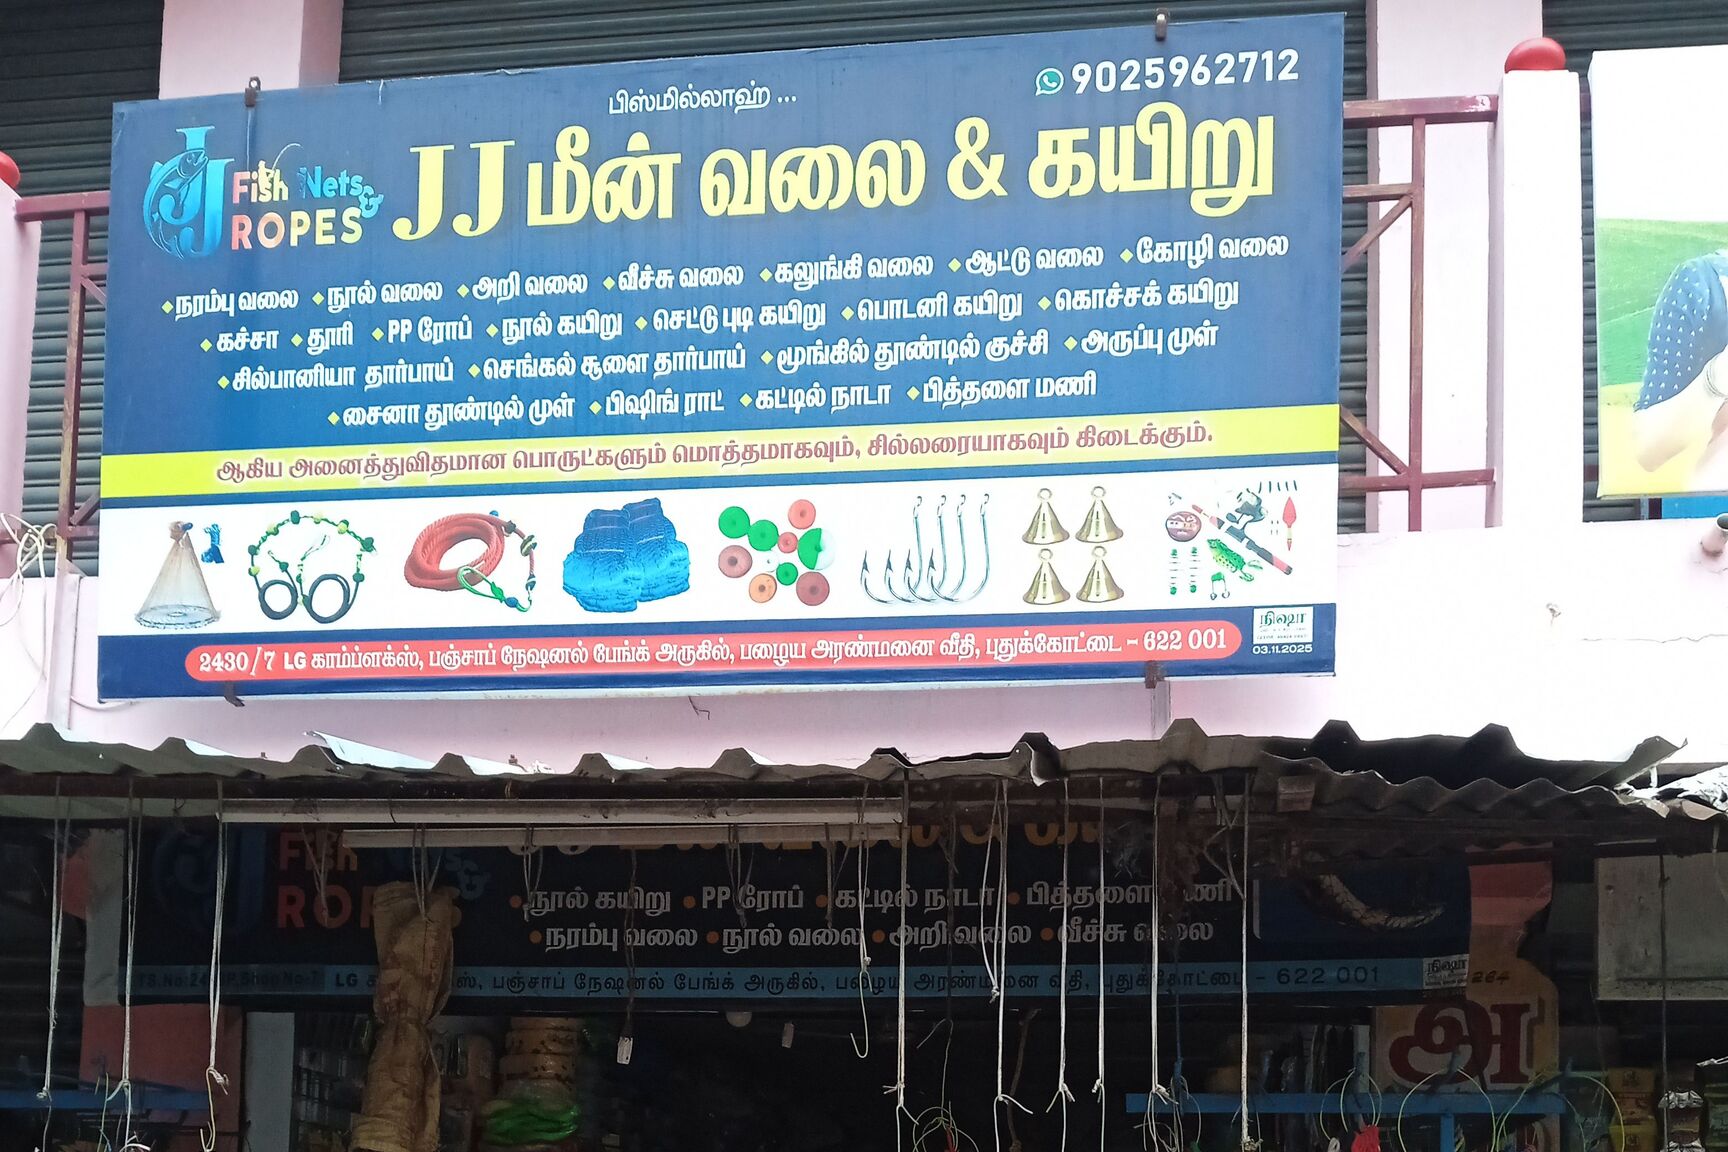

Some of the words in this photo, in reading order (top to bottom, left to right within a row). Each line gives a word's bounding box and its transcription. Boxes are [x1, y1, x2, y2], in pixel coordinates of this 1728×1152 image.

[1071, 49, 1299, 94] 9025962712
[299, 166, 362, 199] Nets
[393, 139, 516, 241] JJ
[526, 124, 682, 227] மீன்
[700, 139, 926, 217] வலை
[946, 115, 1009, 203] &
[1028, 101, 1275, 217] கயிறு
[231, 207, 363, 250] ROPES
[174, 289, 235, 321] நரம்பு
[238, 287, 299, 313] வலை
[327, 279, 376, 314] நூல்
[379, 281, 443, 306] வலை
[472, 271, 521, 304] அறி
[525, 273, 588, 298] வலை
[617, 262, 676, 293] வீச்சு
[679, 265, 744, 289] வலை
[774, 252, 864, 288] கலுங்கி
[867, 254, 934, 279] வலை
[965, 246, 1031, 277] ஆட்டு
[1035, 245, 1104, 271] வலை
[1135, 233, 1214, 267] கோழி
[1218, 235, 1290, 261] வலை
[216, 327, 279, 354] கச்சா
[387, 318, 412, 343] PP
[416, 315, 473, 346] ரோப்
[500, 311, 553, 345] நூல்
[556, 308, 623, 340] கயிறு
[758, 300, 828, 331] கயிறு
[952, 289, 1023, 321] கயிறு
[1166, 277, 1240, 309] கயிறு
[231, 360, 356, 392] சில்பானியா
[364, 354, 454, 390] தார்பாய்
[483, 349, 576, 382] செங்கல்
[580, 347, 649, 381] சூளை
[653, 340, 746, 376] தார்பாய்
[776, 338, 870, 373] மூங்கில்
[874, 332, 981, 371] தூண்டில்
[1167, 318, 1219, 355] முள்
[342, 401, 421, 428] சைனா
[424, 395, 524, 431] தூண்டில்
[528, 393, 576, 427] முள்
[684, 386, 726, 418] ராட்
[754, 379, 828, 414] கட்டில்
[830, 382, 892, 414] நாடா
[922, 373, 1031, 409] பித்தளை
[1035, 369, 1098, 399] மணி
[216, 453, 284, 482] ஆகிய
[287, 447, 510, 484] அனைத்துவிதமான
[512, 440, 667, 475] பொருட்களும்
[866, 425, 1071, 458] சில்லரையாகவும்
[283, 650, 307, 671] LG
[428, 643, 497, 672] பஞ்சாப்
[500, 638, 588, 669] நேஷனல்
[593, 638, 651, 666] பேங்க்
[738, 640, 806, 669] பழைய
[984, 626, 1123, 663] புதுக்கோட்டை
[1142, 628, 1185, 651] 622
[1187, 626, 1228, 650] 001
[1252, 643, 1313, 655] 03.11.2025
[529, 885, 590, 917] நூல்
[594, 886, 672, 917] கயிறு
[702, 885, 732, 910] PP
[545, 920, 619, 953] நரம்பு
[624, 926, 699, 949] வலை
[721, 922, 784, 955] நூல்
[788, 926, 864, 949] வலை
[953, 923, 1033, 946] வலை
[335, 973, 358, 988] LG
[1276, 967, 1326, 985] 622
[1336, 965, 1380, 984] 001
